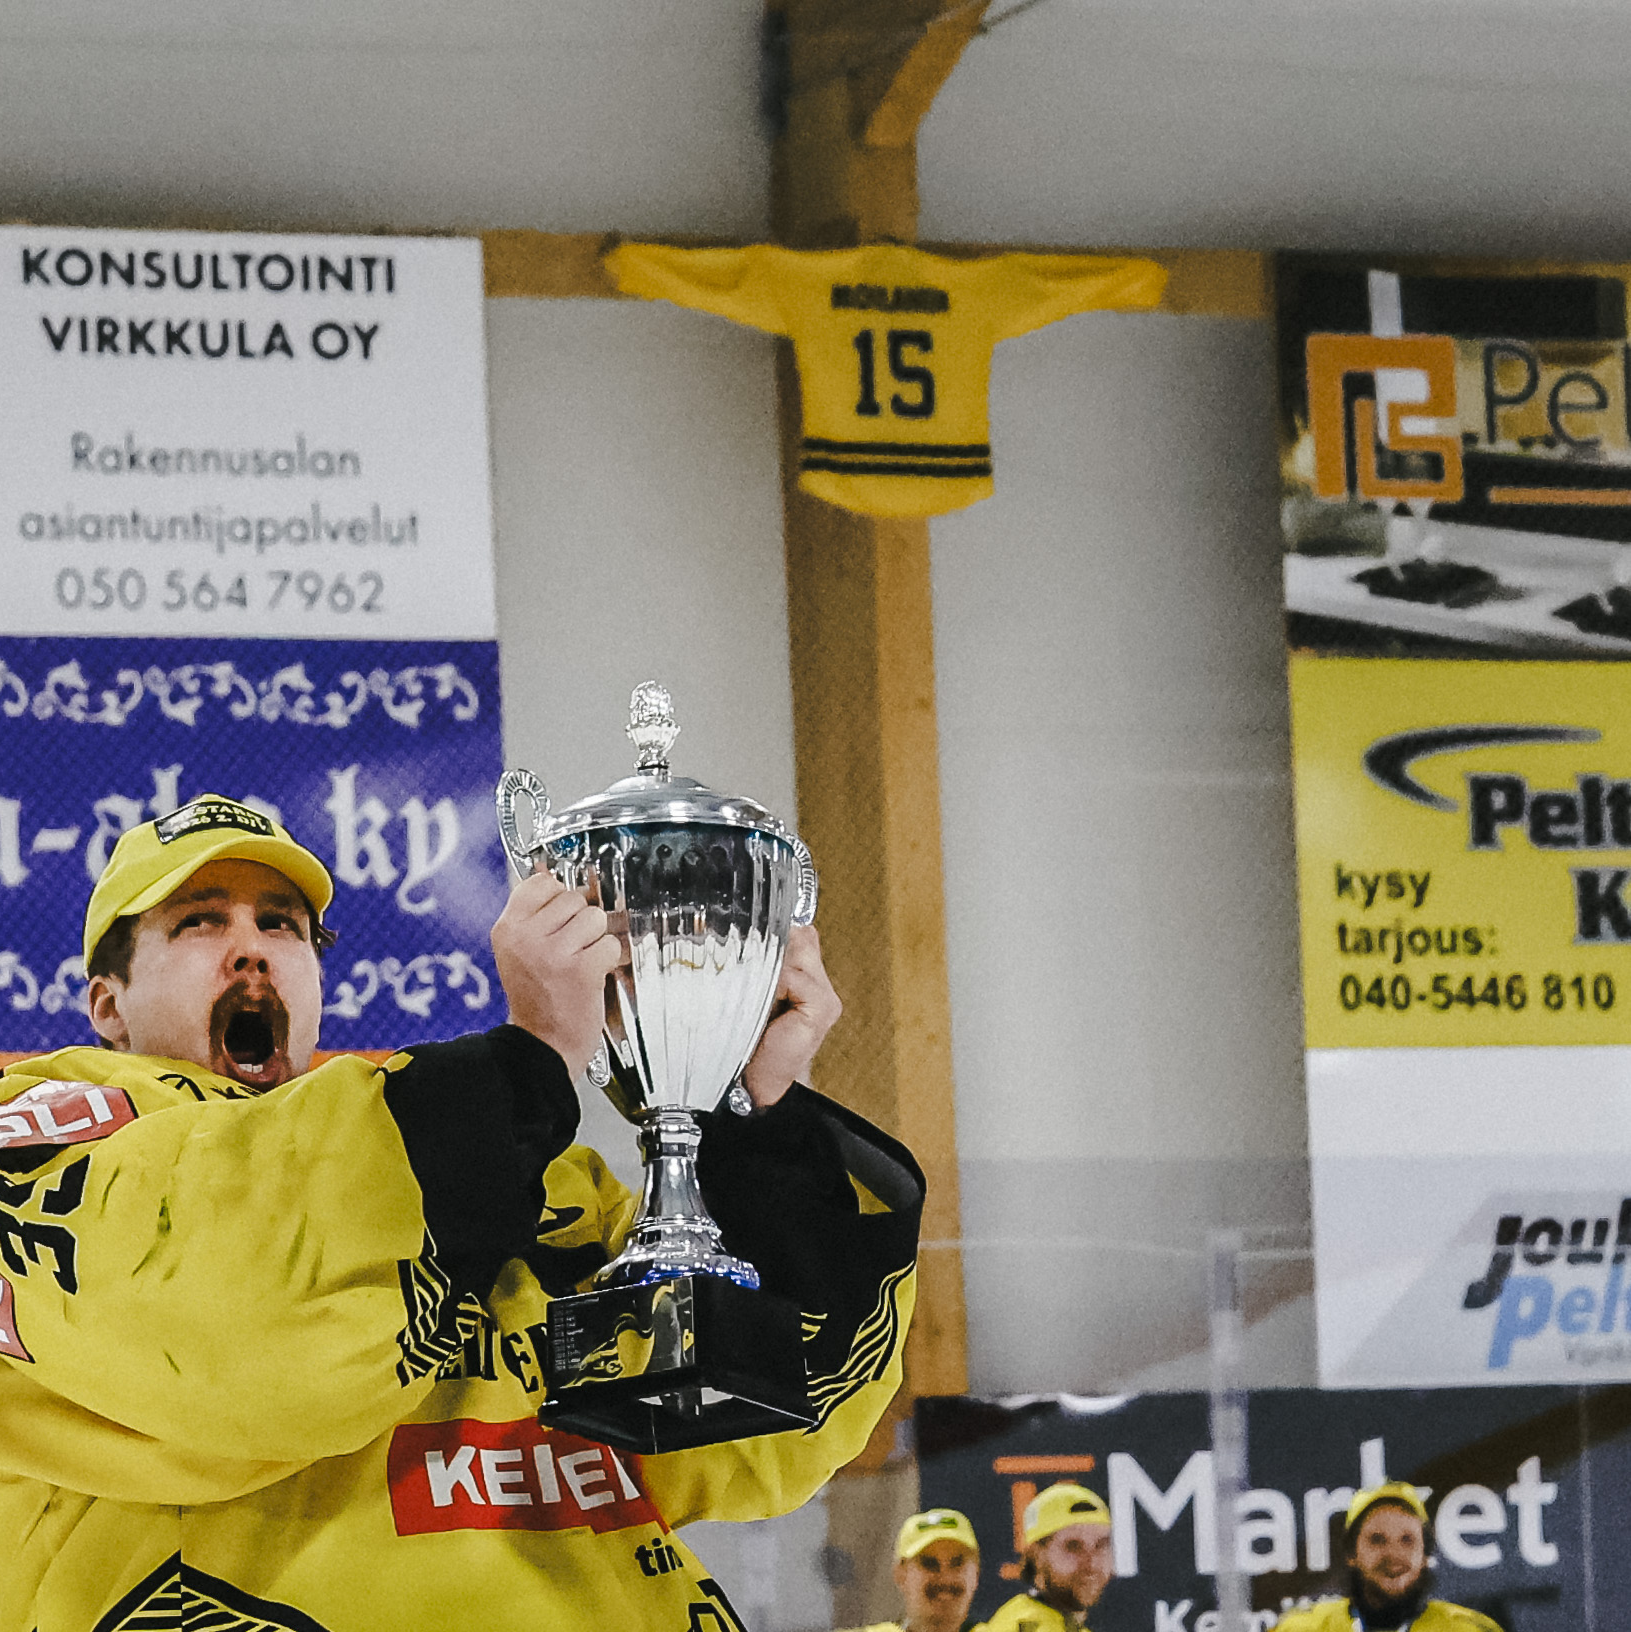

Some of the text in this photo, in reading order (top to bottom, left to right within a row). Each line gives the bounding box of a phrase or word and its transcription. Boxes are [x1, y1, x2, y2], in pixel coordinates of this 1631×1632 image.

[20, 246, 398, 294] KONSULTOINTI
[41, 316, 381, 361] VIRKKULA OY
[853, 328, 936, 420] 15
[70, 432, 362, 479] Rakennusalan
[19, 510, 420, 558] asiantuntijapalvelut
[55, 566, 386, 617] 050 564 7962
[327, 763, 457, 915] ky
[1335, 862, 1431, 909] kysy
[1338, 918, 1499, 964] tarjous:
[1340, 973, 1616, 1013] 040-5446 810
[1487, 1265, 1631, 1370] pel
